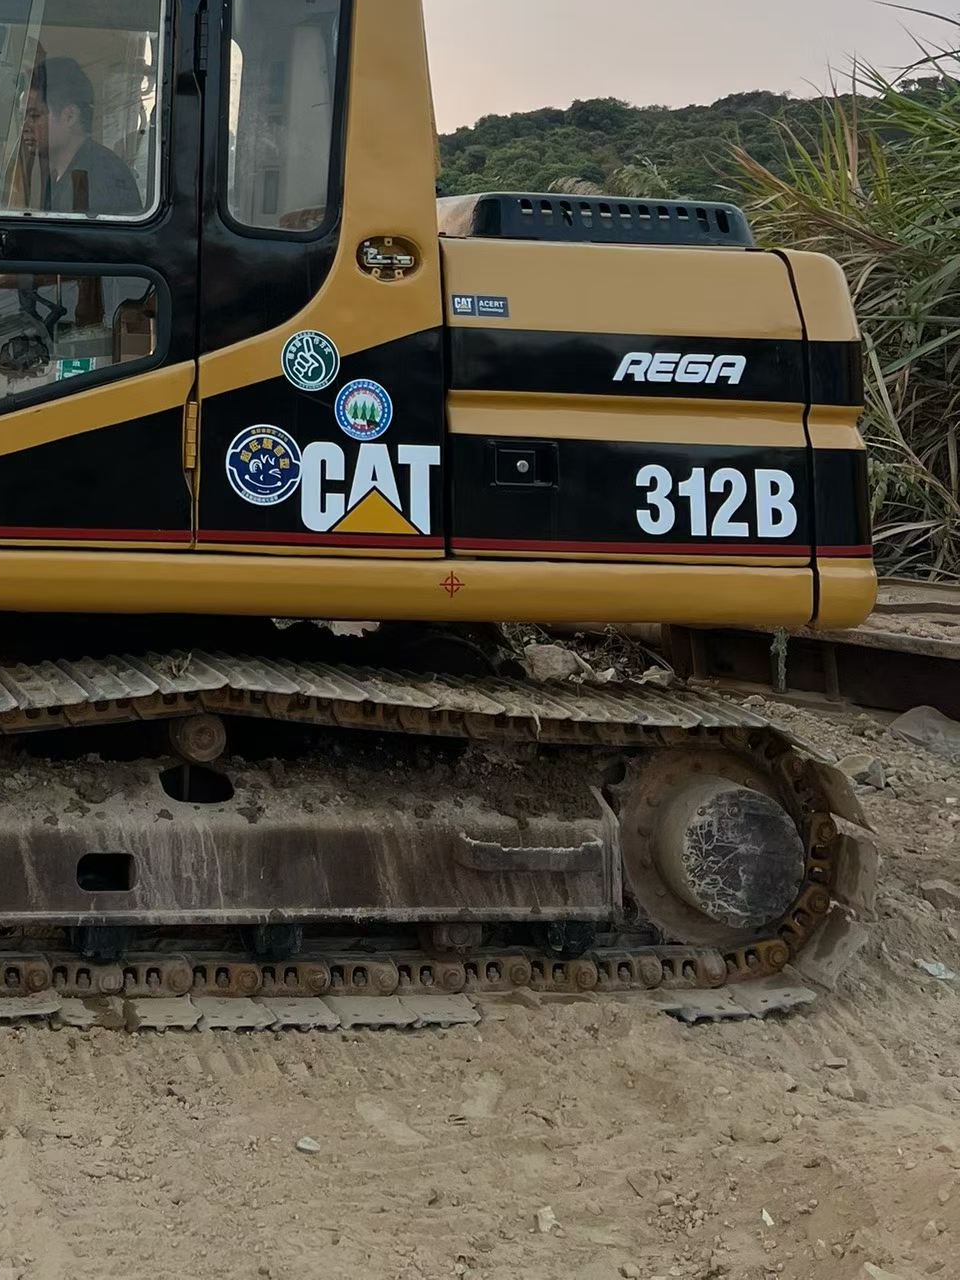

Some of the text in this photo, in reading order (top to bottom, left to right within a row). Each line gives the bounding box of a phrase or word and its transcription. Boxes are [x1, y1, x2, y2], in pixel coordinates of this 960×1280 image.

[454, 297, 473, 309] CAT
[479, 300, 505, 308] ACERT
[612, 352, 747, 385] REGA
[301, 441, 441, 535] CAT
[635, 464, 798, 538] 312B
